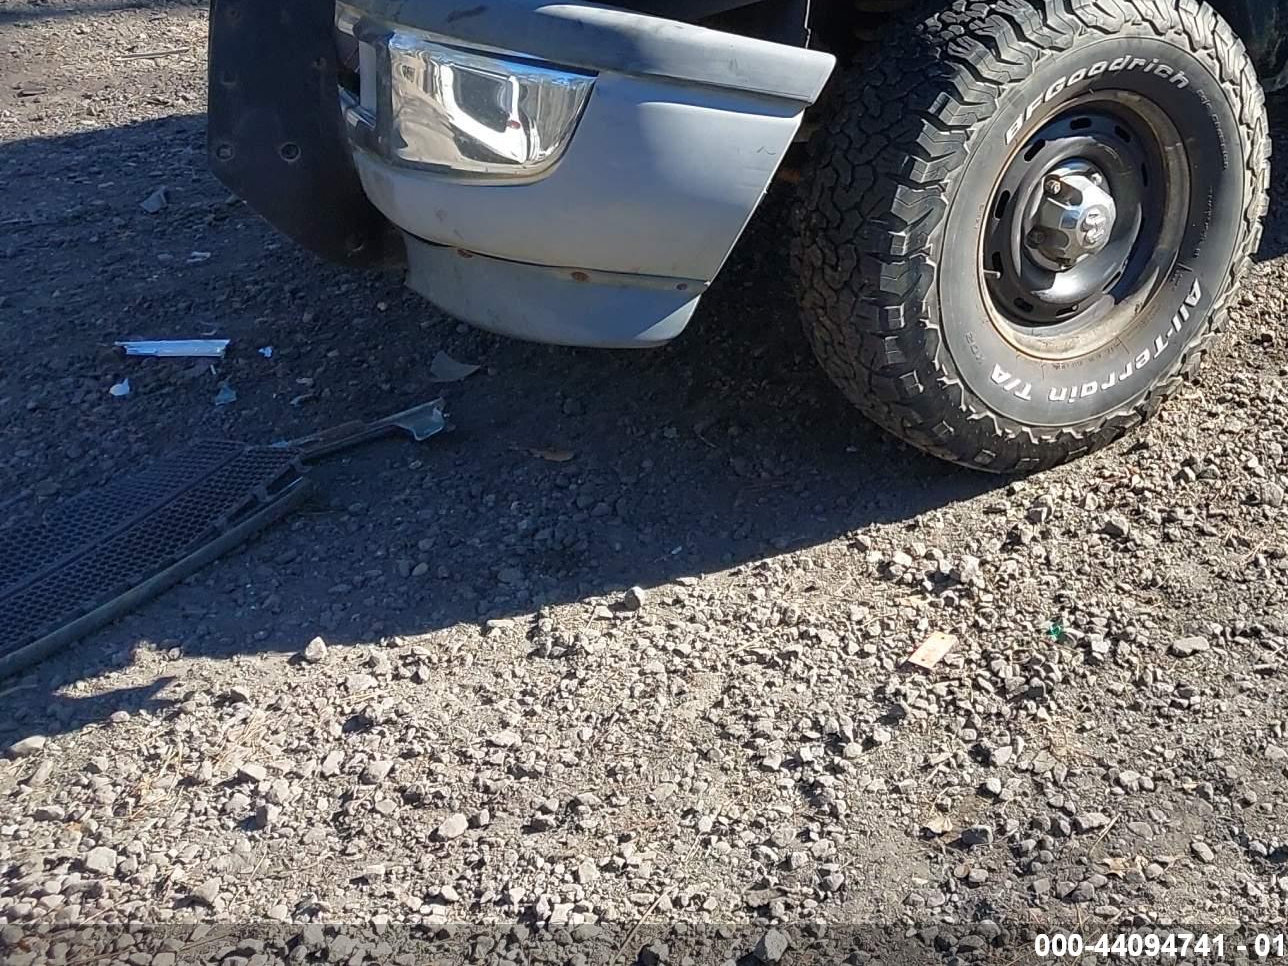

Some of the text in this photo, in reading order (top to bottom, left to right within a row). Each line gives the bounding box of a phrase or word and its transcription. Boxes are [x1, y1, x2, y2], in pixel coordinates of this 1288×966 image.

[1005, 54, 1190, 145] BFGoodrich
[990, 363, 1032, 401] T/A
[1047, 277, 1202, 404] All-Terrain
